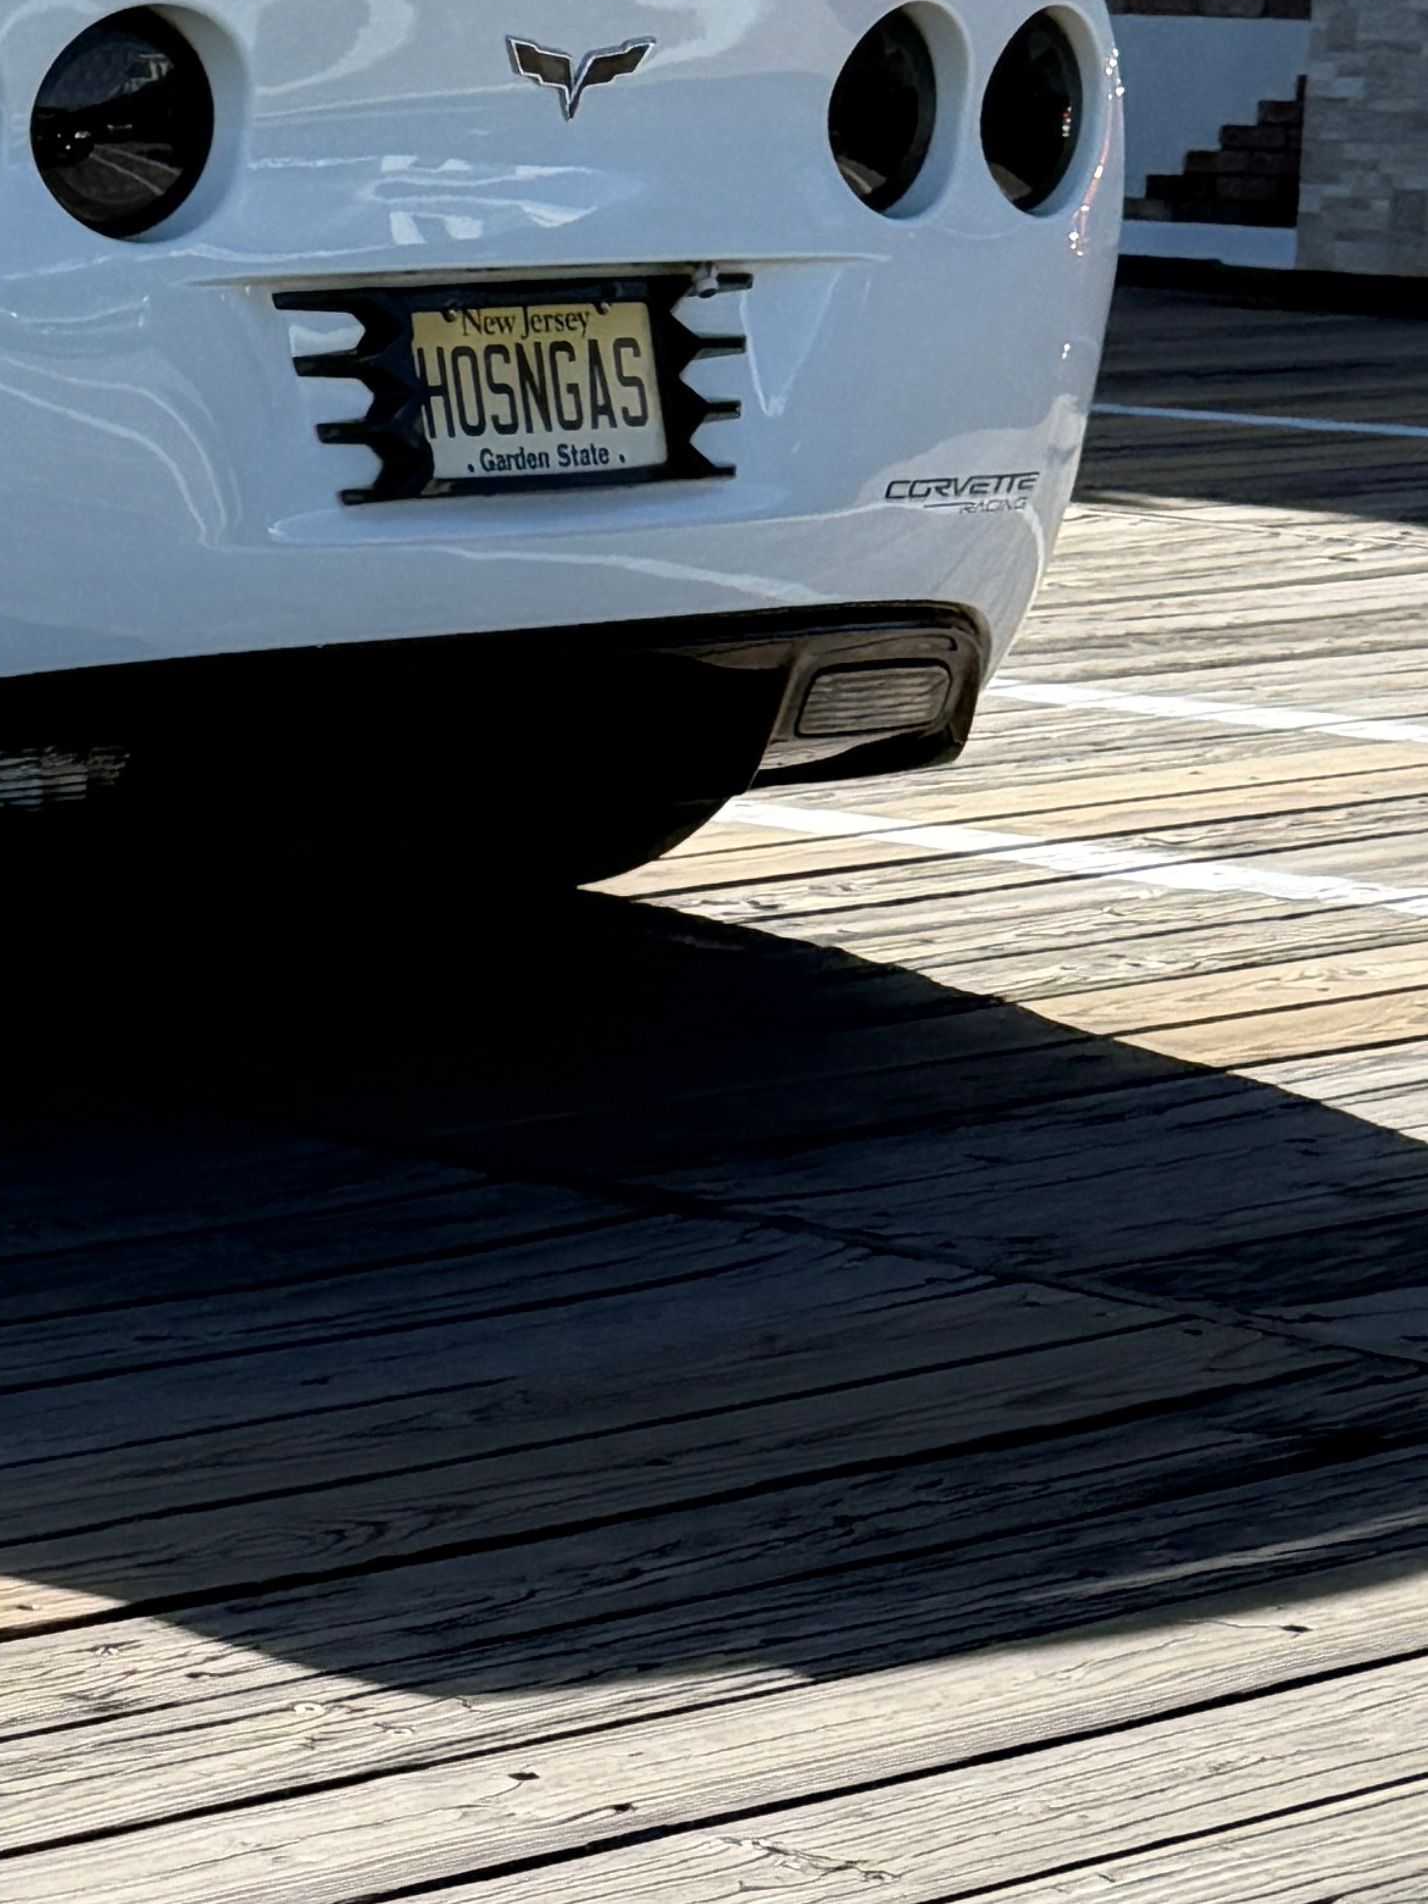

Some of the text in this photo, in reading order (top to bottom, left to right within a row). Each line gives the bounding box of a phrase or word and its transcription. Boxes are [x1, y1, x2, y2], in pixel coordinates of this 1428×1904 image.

[461, 306, 591, 339] New Jersey
[416, 336, 649, 440] HOSNGAS
[479, 443, 610, 474] Garden State
[884, 471, 1041, 500] CORVETTE
